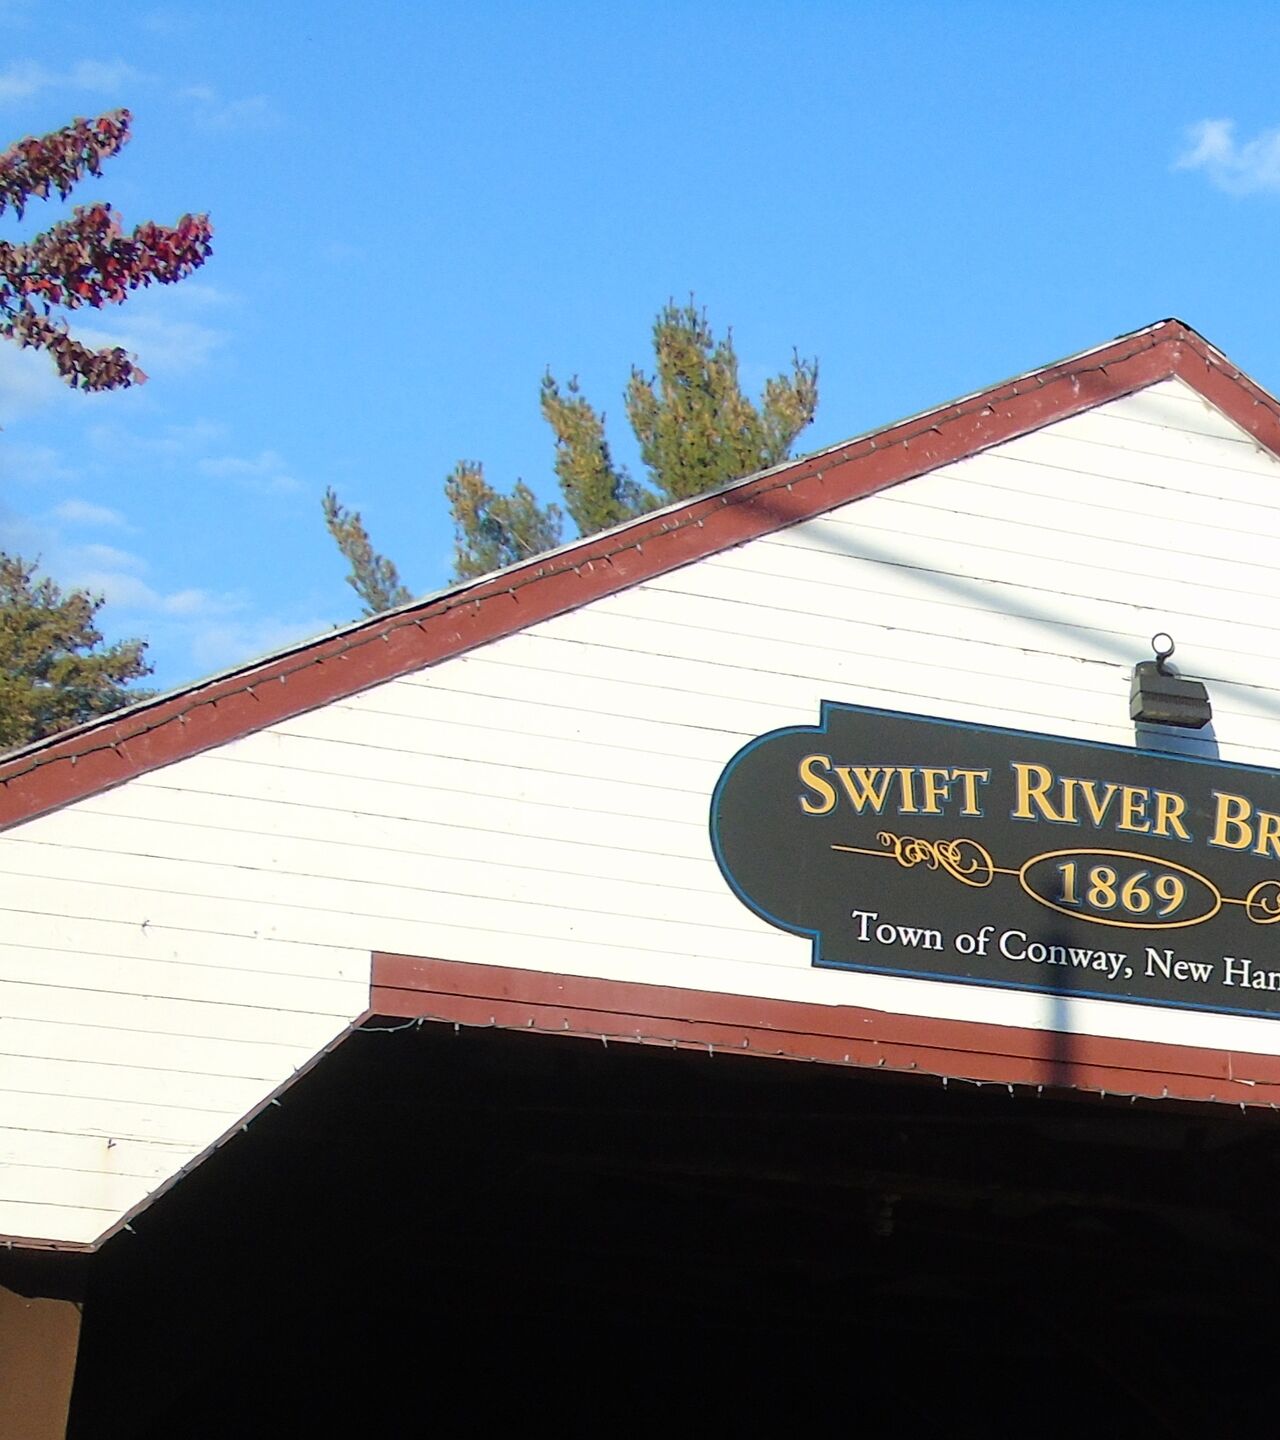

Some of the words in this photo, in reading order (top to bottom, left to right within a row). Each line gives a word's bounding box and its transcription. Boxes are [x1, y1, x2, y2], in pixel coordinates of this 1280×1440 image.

[798, 753, 988, 817] SWIFT
[1012, 762, 1192, 841] RIVER
[1056, 861, 1186, 916] 1869
[851, 910, 944, 951] Town
[955, 927, 995, 957] of
[999, 931, 1134, 978] Conway,
[1145, 948, 1212, 984] New
